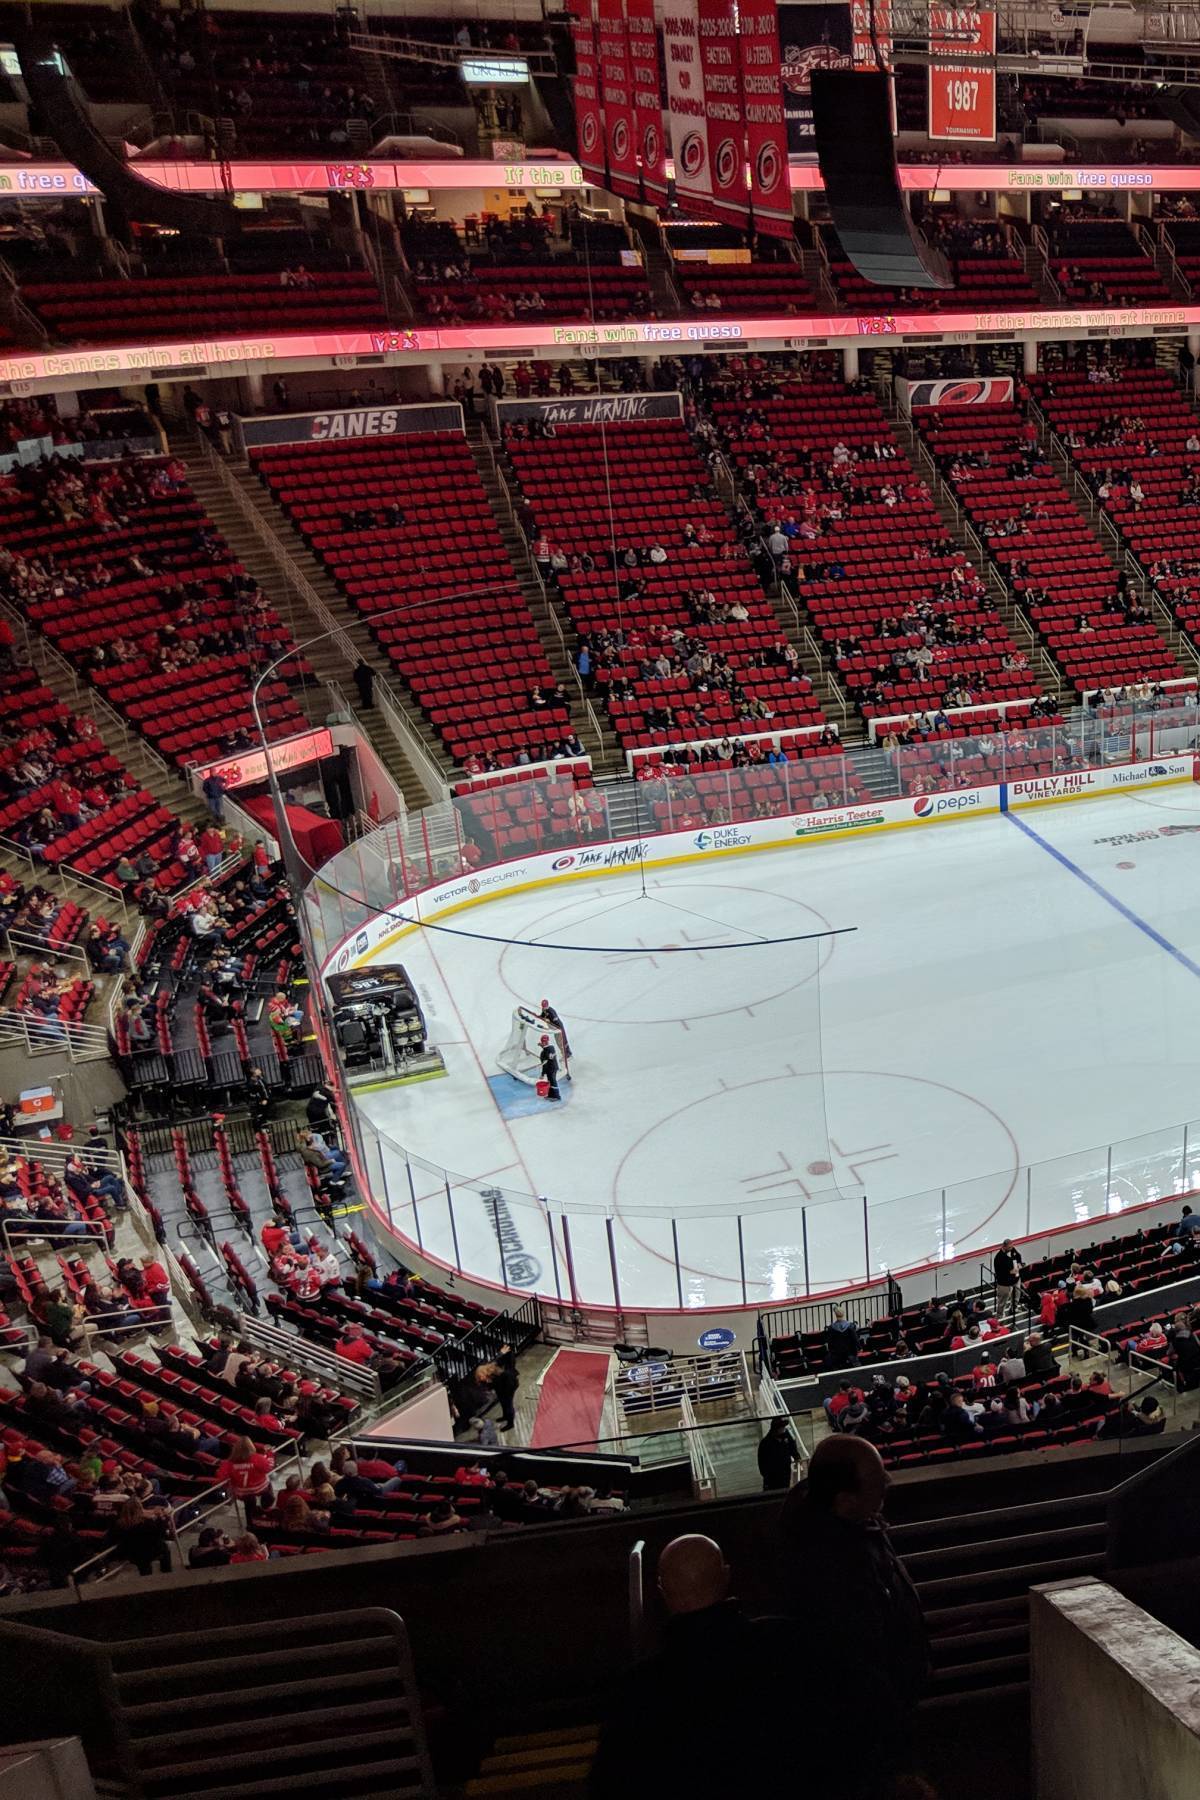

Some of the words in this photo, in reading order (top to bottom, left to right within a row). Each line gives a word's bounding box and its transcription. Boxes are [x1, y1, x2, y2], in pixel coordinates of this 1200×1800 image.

[947, 80, 979, 111] 1987
[18, 171, 66, 189] free
[530, 167, 565, 185] the
[1008, 170, 1043, 186] Fans
[1046, 171, 1074, 185] win
[1077, 170, 1107, 186] free
[1110, 172, 1153, 190] queso
[995, 313, 1026, 329] the
[1030, 312, 1082, 329] Canes
[1086, 311, 1116, 326] win
[1119, 311, 1138, 324] at
[1141, 308, 1186, 323] home
[554, 328, 599, 344] Fans
[603, 326, 639, 342] win
[643, 325, 681, 341] free
[686, 323, 743, 341] queso
[43, 354, 121, 377] Canes
[127, 347, 171, 369] win
[180, 345, 205, 364] at
[209, 341, 275, 363] home
[541, 403, 577, 422] TAKE
[584, 397, 648, 422] WARNING
[312, 410, 398, 440] CANES
[1013, 778, 1059, 795] BULLY
[1064, 773, 1095, 787] HILL
[1112, 769, 1148, 784] Michael
[1168, 764, 1185, 775] Son
[936, 792, 981, 813] pepsi
[1028, 785, 1082, 800] VINEYARDS
[806, 813, 844, 827] Harris
[846, 809, 883, 821] Teeter
[713, 828, 739, 839] DUKE
[714, 836, 752, 849] ENERGY
[1093, 833, 1136, 845] TICKET
[577, 849, 603, 866] TAKE
[604, 841, 649, 867] WARNING
[433, 886, 467, 904] VECTOR
[240, 1471, 249, 1487] 7
